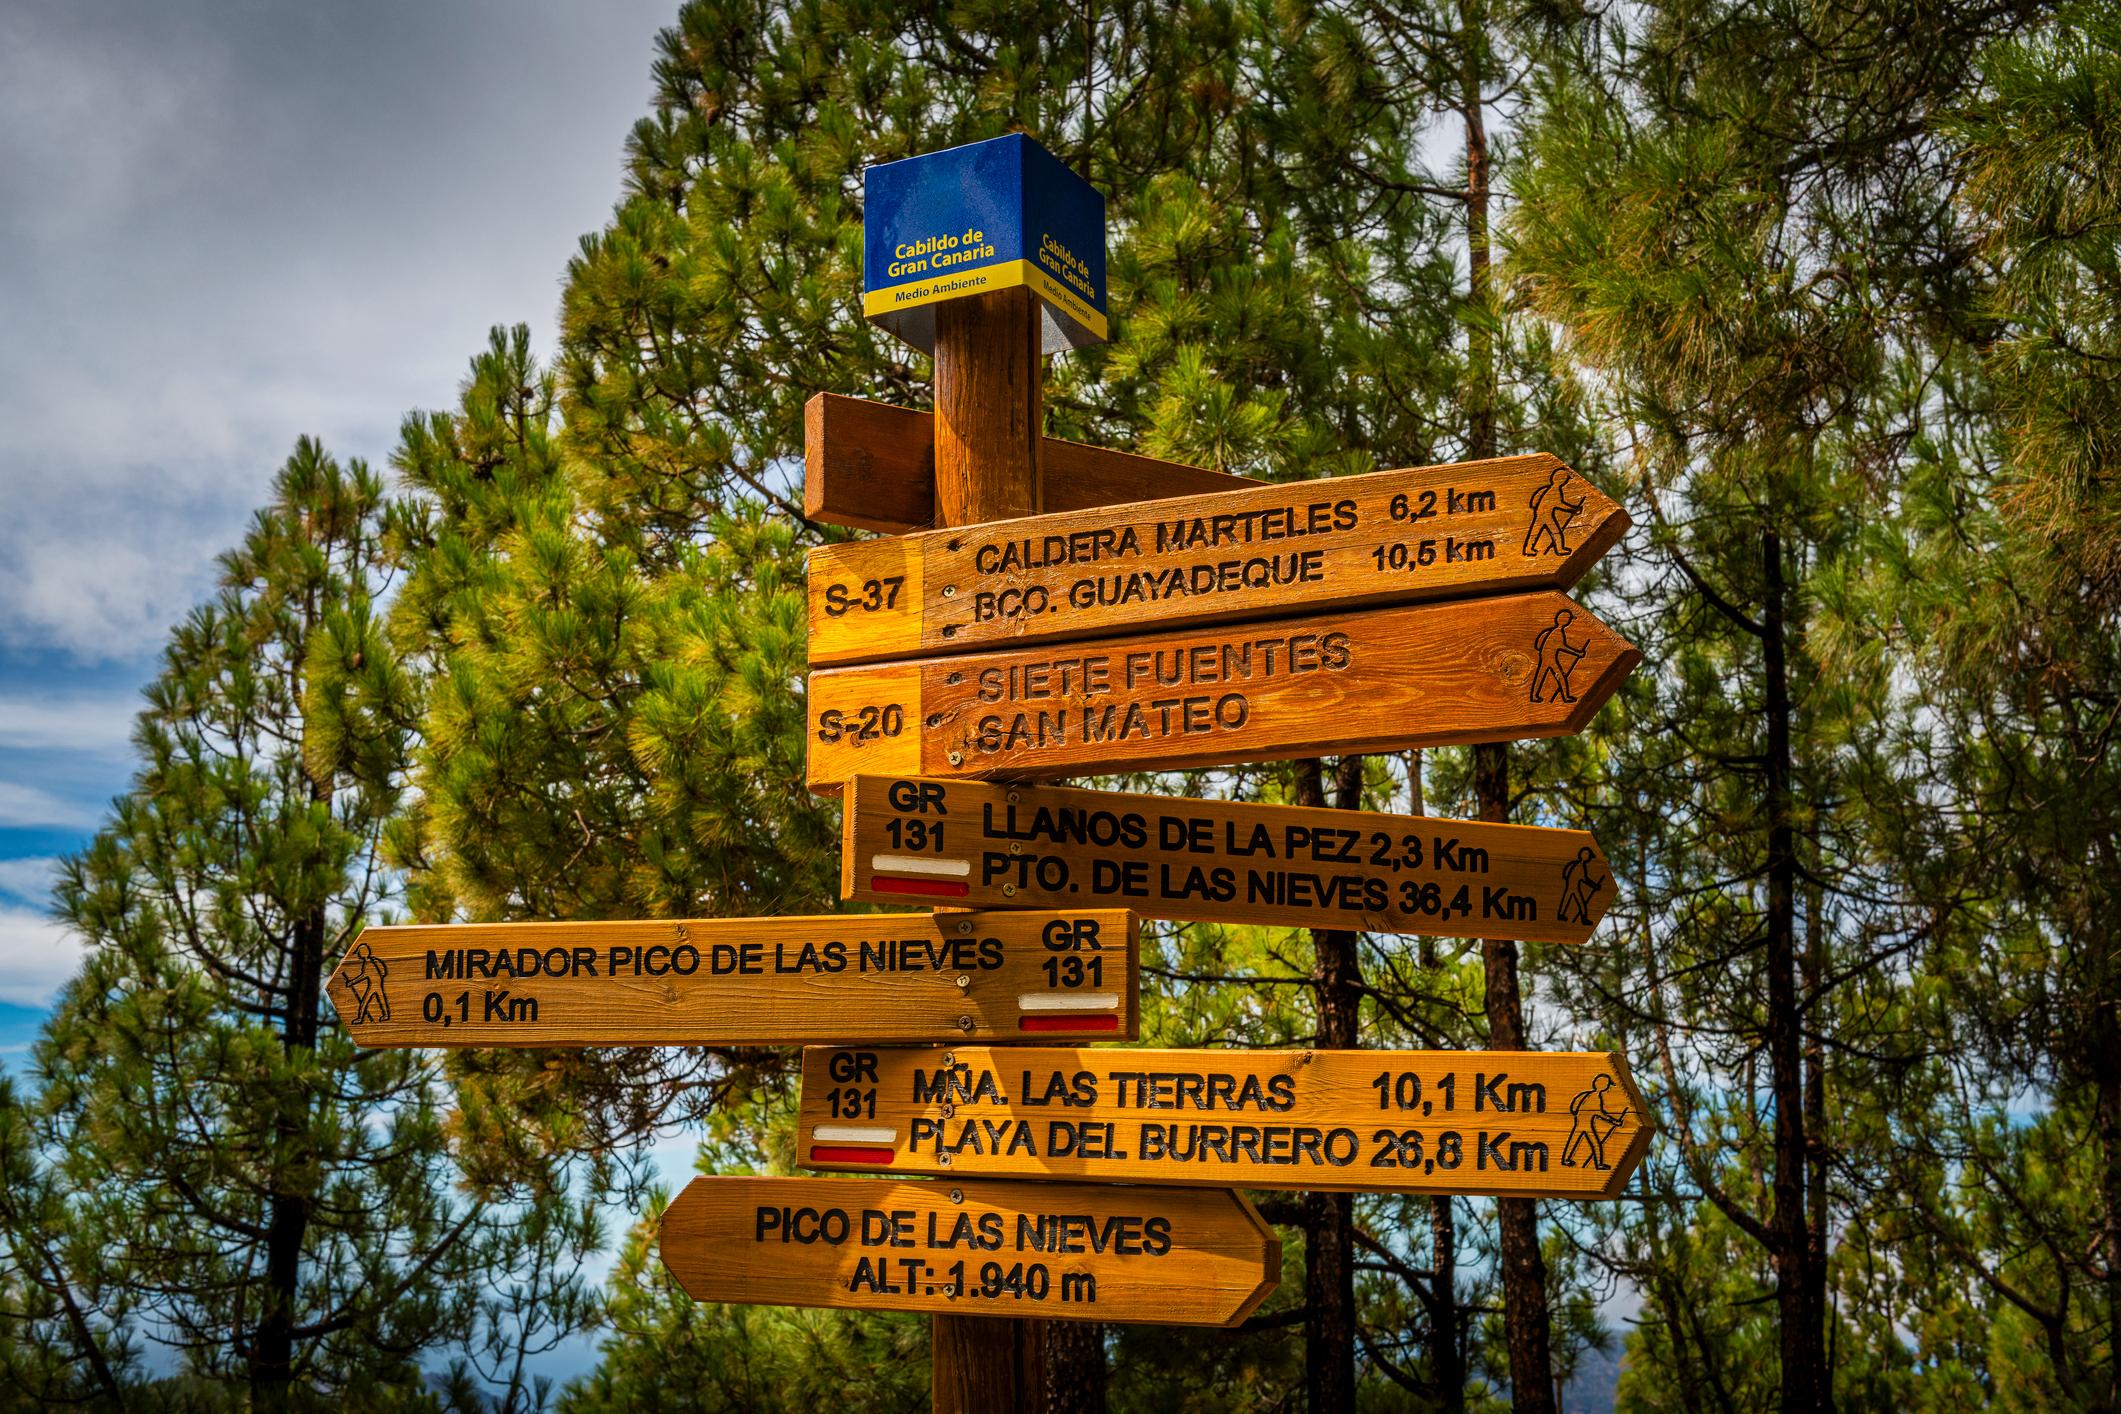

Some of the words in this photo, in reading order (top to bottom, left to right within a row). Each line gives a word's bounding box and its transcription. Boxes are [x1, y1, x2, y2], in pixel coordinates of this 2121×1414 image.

[888, 258, 927, 278] Gran
[931, 243, 995, 268] Canaria
[895, 233, 959, 260] Cabildo
[962, 228, 983, 246] de
[1042, 233, 1078, 268] Cabildo
[1079, 260, 1089, 278] de
[895, 287, 929, 302] Medio
[932, 275, 987, 295] Ambiente
[1039, 247, 1061, 275] Gran
[1062, 265, 1095, 299] Canaria
[1043, 279, 1062, 300] Medio
[1063, 294, 1092, 322] Ambiente
[975, 527, 1142, 576] CALDERA
[1156, 499, 1358, 552] MARTELES
[1389, 490, 1437, 524] 6,2
[1447, 488, 1496, 515] km
[825, 576, 905, 617] S-37
[974, 585, 1058, 623] BCO.
[1069, 550, 1324, 611] GUAYADEQUE
[1372, 542, 1437, 573] 10,5
[1446, 537, 1495, 564] km
[977, 656, 1110, 705] SIETE
[1126, 632, 1352, 690] FUENTES
[818, 703, 904, 745] S-20
[977, 709, 1067, 754] SAN
[1083, 693, 1250, 745] MATEO
[888, 781, 948, 815] GR
[886, 818, 945, 853] 131
[983, 802, 1148, 849] LLANOS
[1159, 816, 1215, 854] DE
[1226, 821, 1276, 858] LA
[1285, 826, 1361, 864] PEZ
[1370, 832, 1424, 872] 2,3
[1434, 837, 1489, 873] Km
[982, 851, 1079, 893] PTO.
[1092, 859, 1149, 897] DE
[1161, 864, 1236, 902] LAS
[1247, 869, 1389, 913] NIEVES
[1399, 880, 1472, 921] 36,4
[1482, 887, 1537, 922] Km
[1042, 919, 1102, 952] GR
[425, 946, 598, 980] MIRADOR
[608, 943, 700, 977] PICO
[711, 944, 764, 975] DE
[776, 941, 847, 973] LAS
[859, 938, 1004, 972] NIEVES
[1042, 955, 1102, 988] 131
[422, 991, 469, 1028] 0,1
[484, 991, 538, 1022] Km
[828, 1052, 879, 1085] GR
[913, 1062, 1008, 1106] MÑA.
[1022, 1070, 1098, 1108] LAS
[1109, 1072, 1296, 1113] TIERRAS
[1372, 1071, 1456, 1117] 10,1
[1475, 1072, 1546, 1114] Km
[826, 1087, 877, 1120] 131
[909, 1118, 1038, 1157] PLAYA
[1048, 1121, 1127, 1160] DEL
[1139, 1123, 1359, 1167] BURRERO
[1371, 1129, 1463, 1176] 26,8
[1477, 1131, 1549, 1173] Km
[756, 1206, 850, 1246] PICO
[861, 1209, 917, 1249] DE
[927, 1211, 1004, 1251] LAS
[1016, 1214, 1172, 1257] NIEVES
[849, 1256, 935, 1296] ALT:
[948, 1260, 1049, 1302] 1.940
[1061, 1271, 1097, 1304] m
